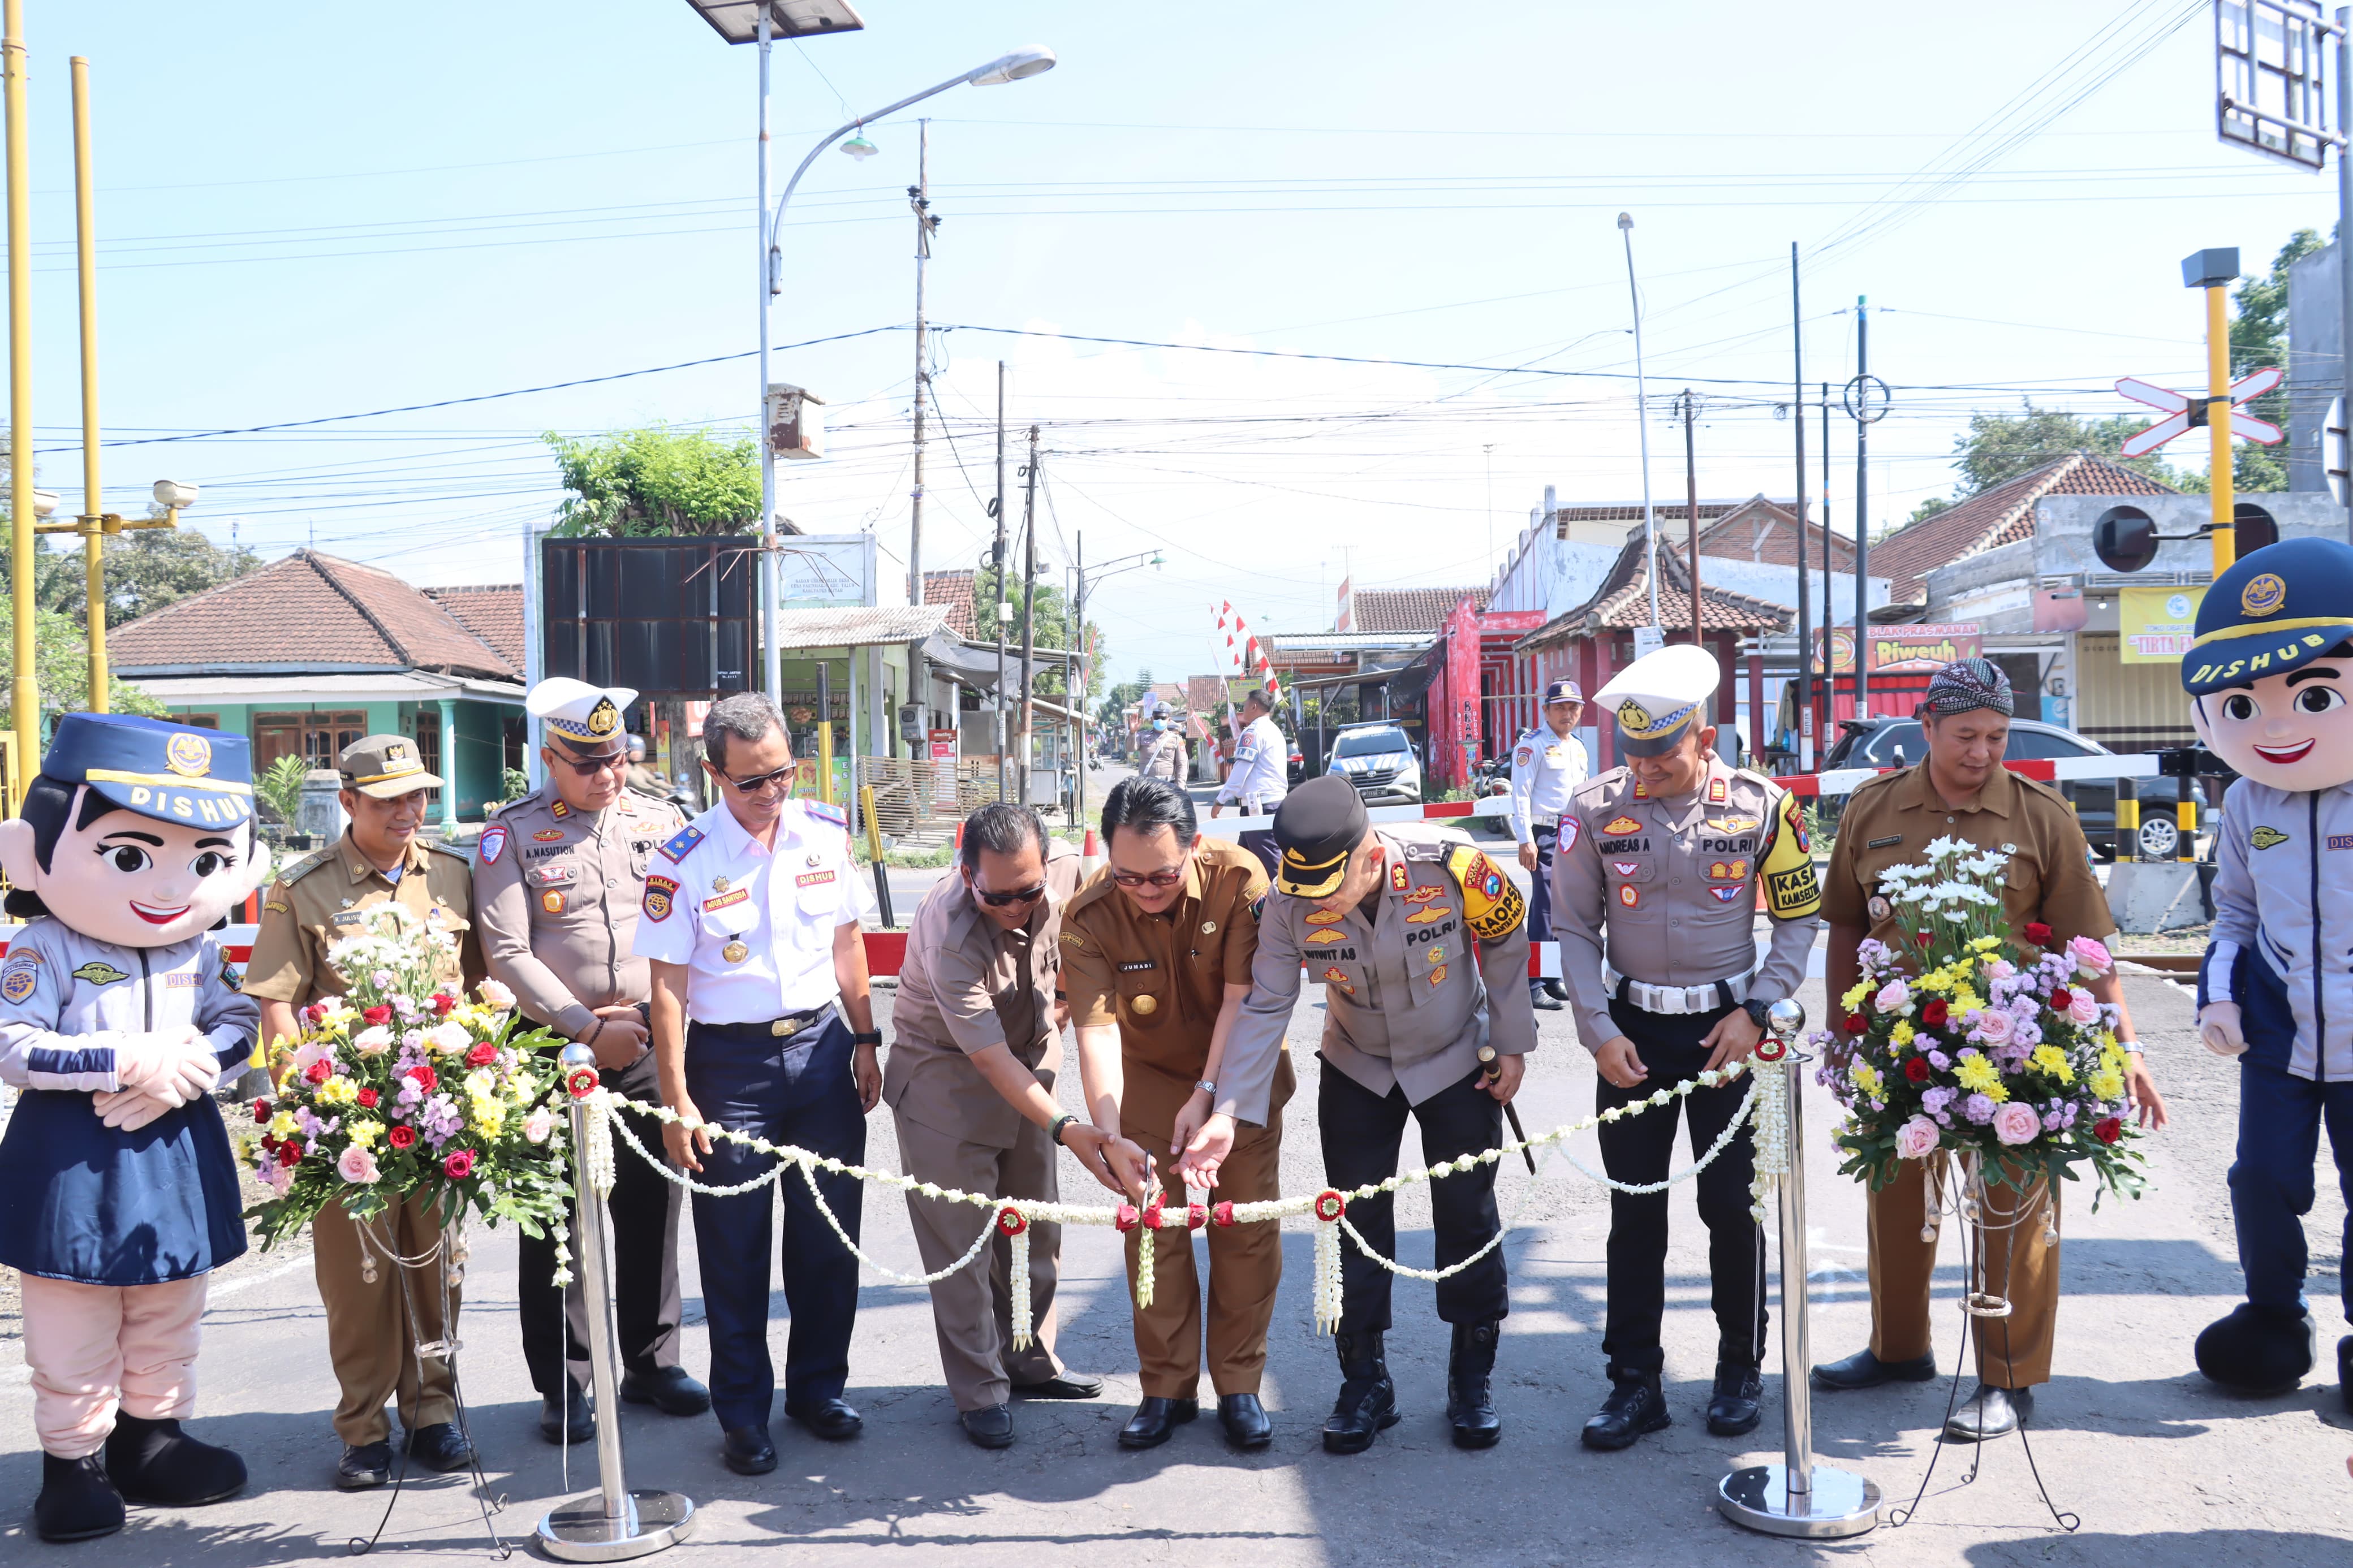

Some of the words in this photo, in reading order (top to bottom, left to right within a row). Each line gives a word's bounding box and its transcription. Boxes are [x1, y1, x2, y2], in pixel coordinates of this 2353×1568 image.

[1902, 624, 1979, 637] PRASMANAN
[1876, 640, 1957, 666] Riweuh
[2189, 634, 2325, 683] DISHUB
[131, 787, 251, 822] DISHUB
[526, 845, 575, 859] A.NASUTION
[1643, 837, 1650, 852] A
[1703, 839, 1752, 853] POLRI
[799, 871, 834, 884] DISHUB
[706, 898, 722, 910] AGUS
[722, 890, 747, 905] SANTOSA
[1406, 919, 1456, 947] POLRI
[1304, 949, 1337, 961] WIWIT
